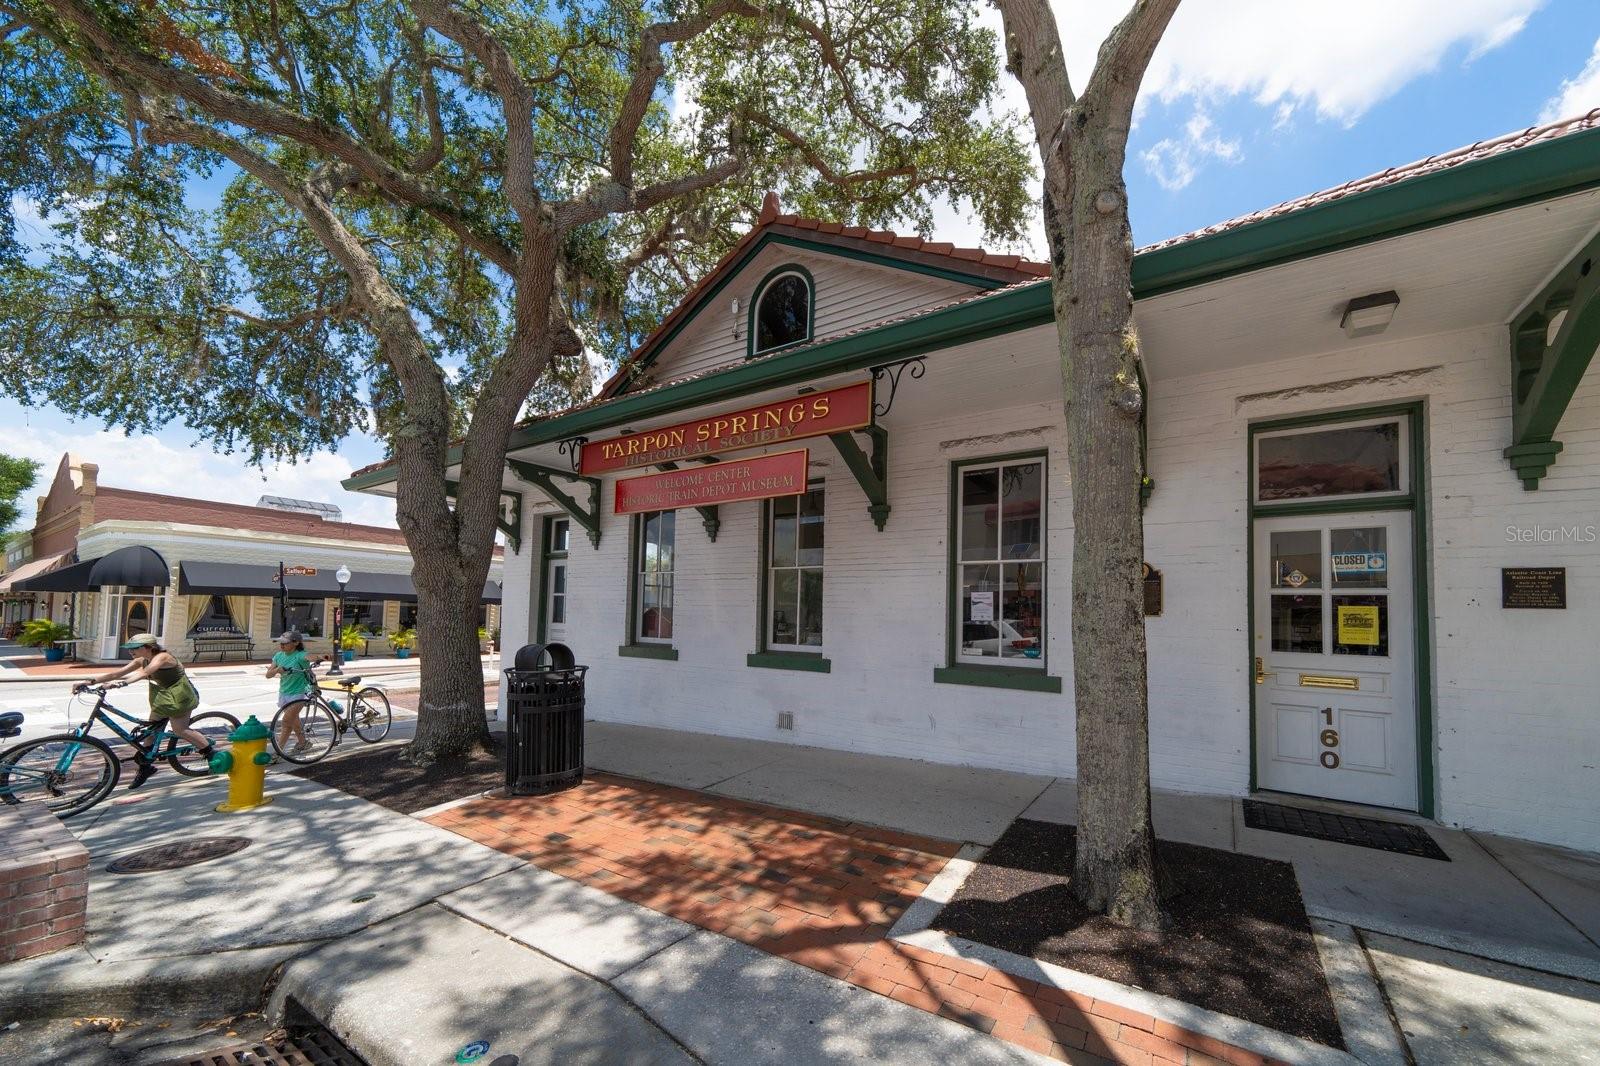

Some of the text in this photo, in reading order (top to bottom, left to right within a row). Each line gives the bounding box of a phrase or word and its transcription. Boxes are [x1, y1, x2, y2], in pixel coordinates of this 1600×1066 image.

[602, 398, 830, 459] TARPON SPRINGS
[624, 424, 797, 466] HISTORICAL SOCIETY
[622, 475, 794, 507] HISTORIC TRAIN DEPOT MUSEUM
[655, 466, 752, 489] WELCOME CENTER
[1334, 554, 1366, 566] CLOSED
[1320, 707, 1340, 769] 160
